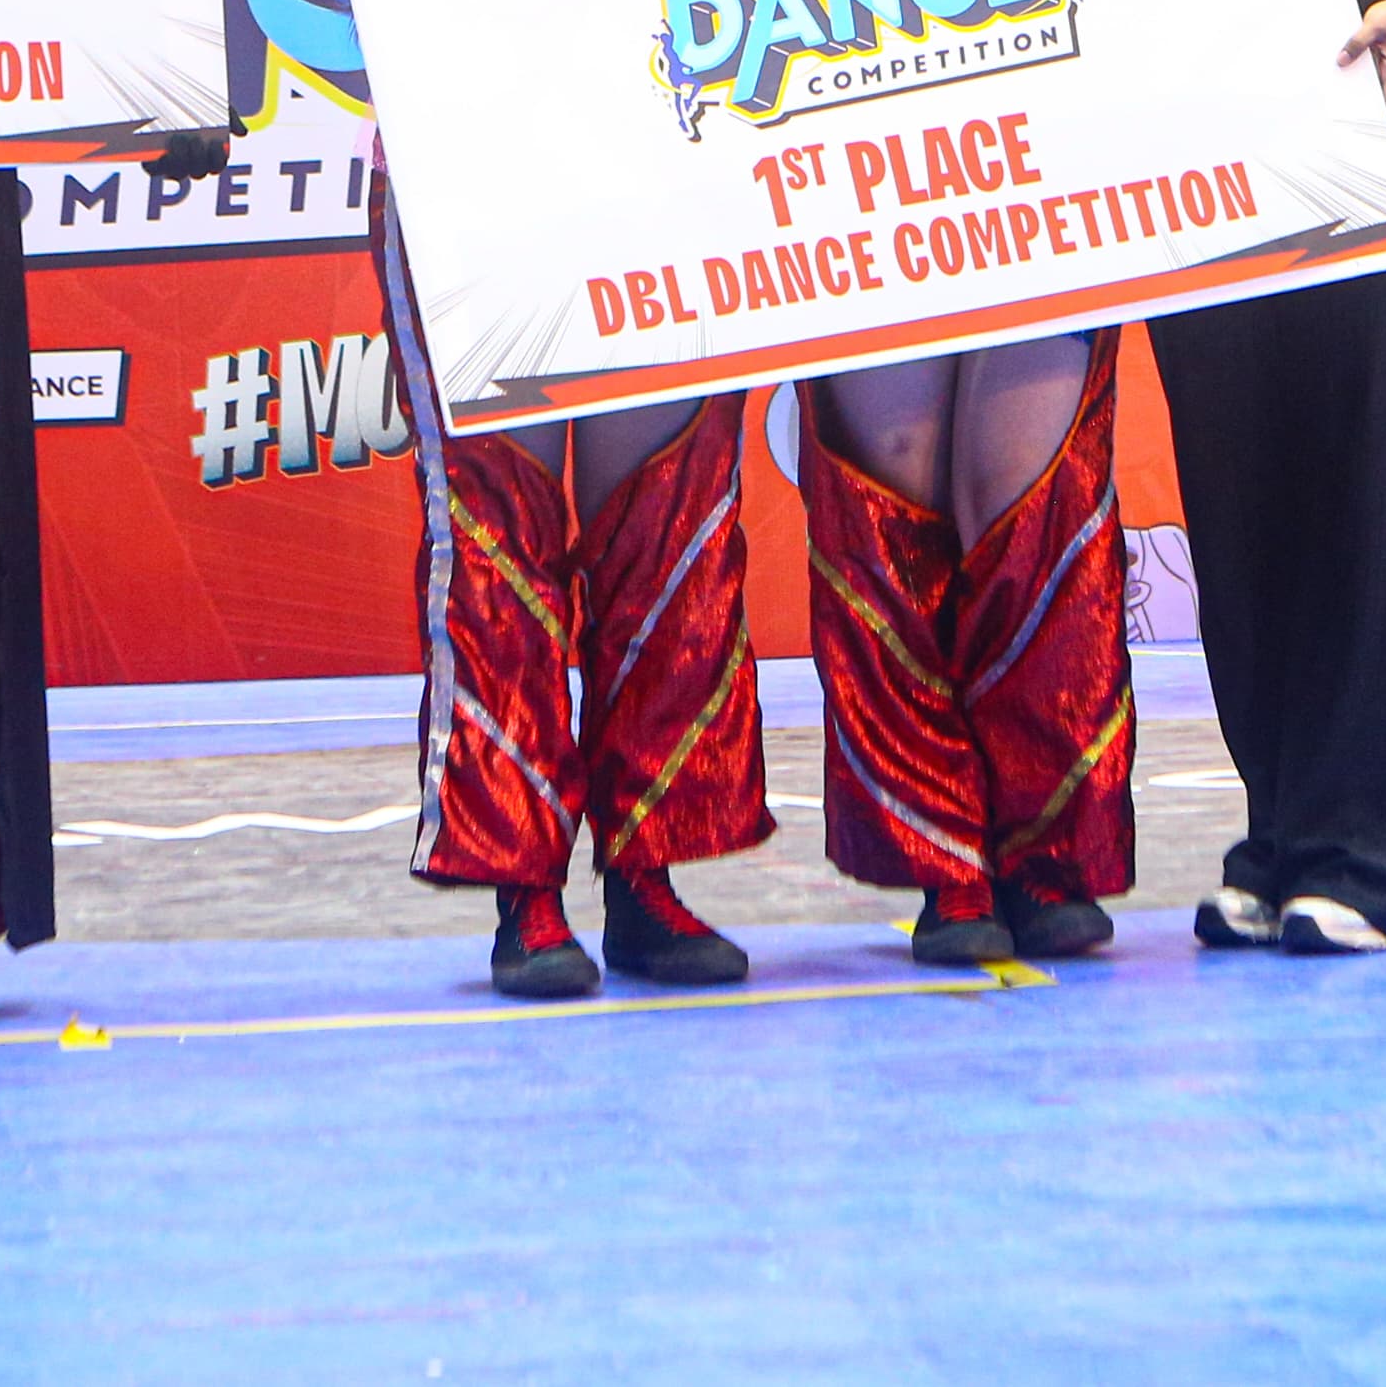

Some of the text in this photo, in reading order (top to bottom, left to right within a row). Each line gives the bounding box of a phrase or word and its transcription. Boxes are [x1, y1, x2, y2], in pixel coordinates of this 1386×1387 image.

[807, 25, 1060, 96] COMPETITION
[752, 111, 1043, 228] 1ST PLACE
[585, 160, 1259, 338] DBL DANCE COMPETITION
